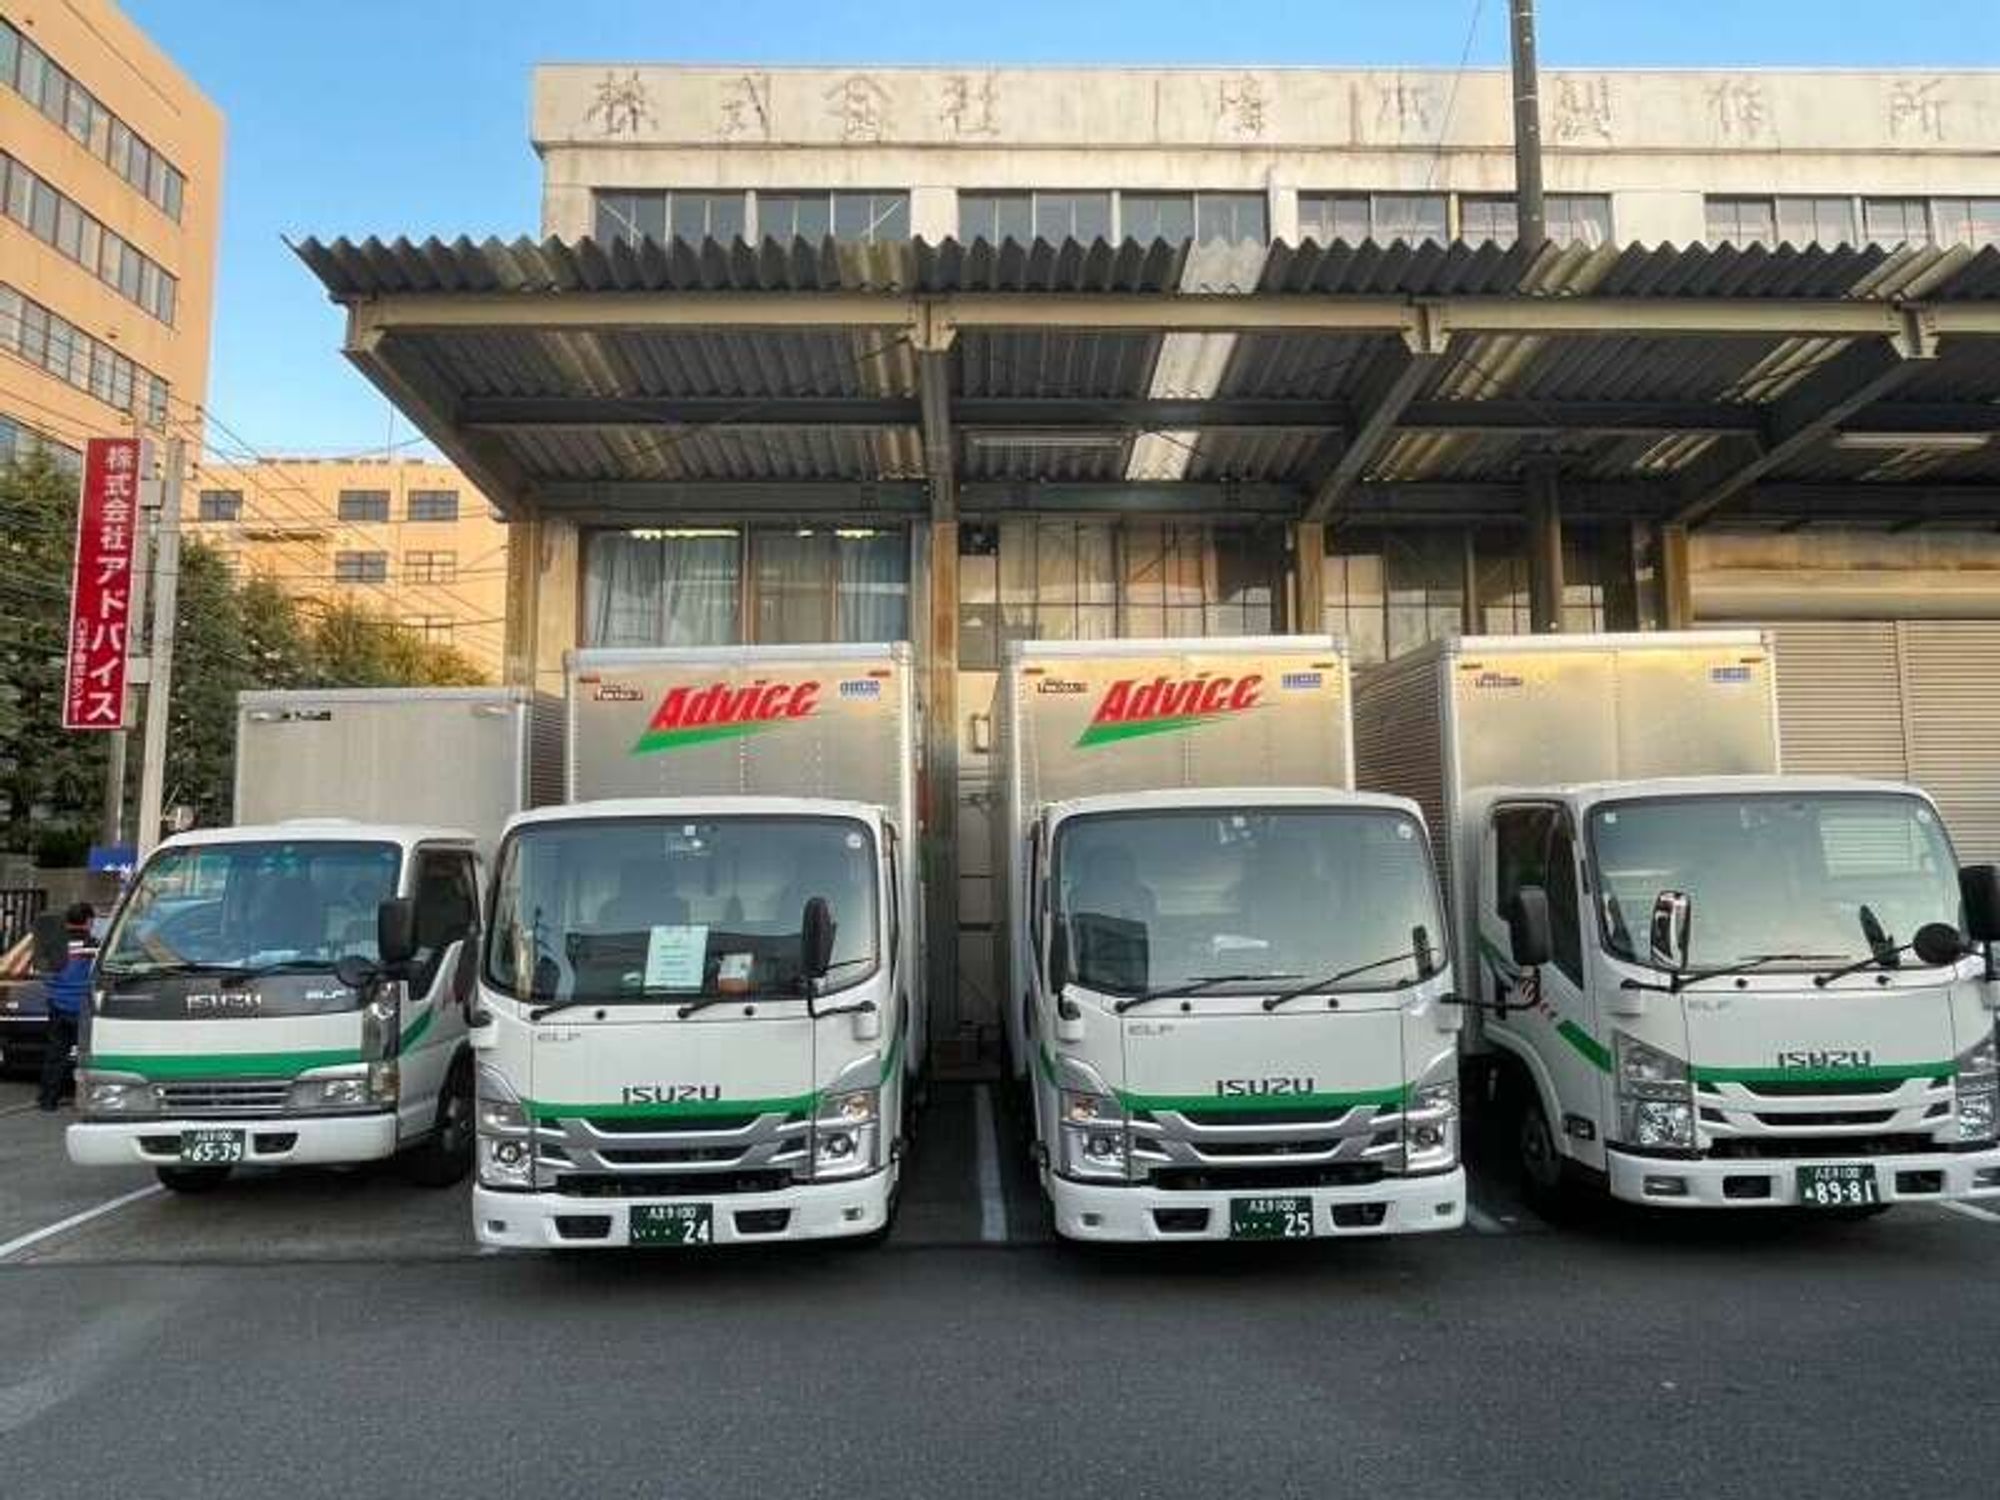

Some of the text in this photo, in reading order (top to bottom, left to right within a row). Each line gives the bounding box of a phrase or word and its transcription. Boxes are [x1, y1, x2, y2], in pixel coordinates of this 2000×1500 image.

[649, 680, 820, 731] Advice
[1092, 671, 1263, 723] Advice
[1777, 1051, 1871, 1068] ISUZU
[621, 1085, 721, 1104] ISUZU
[1216, 1078, 1314, 1096] ISUZU
